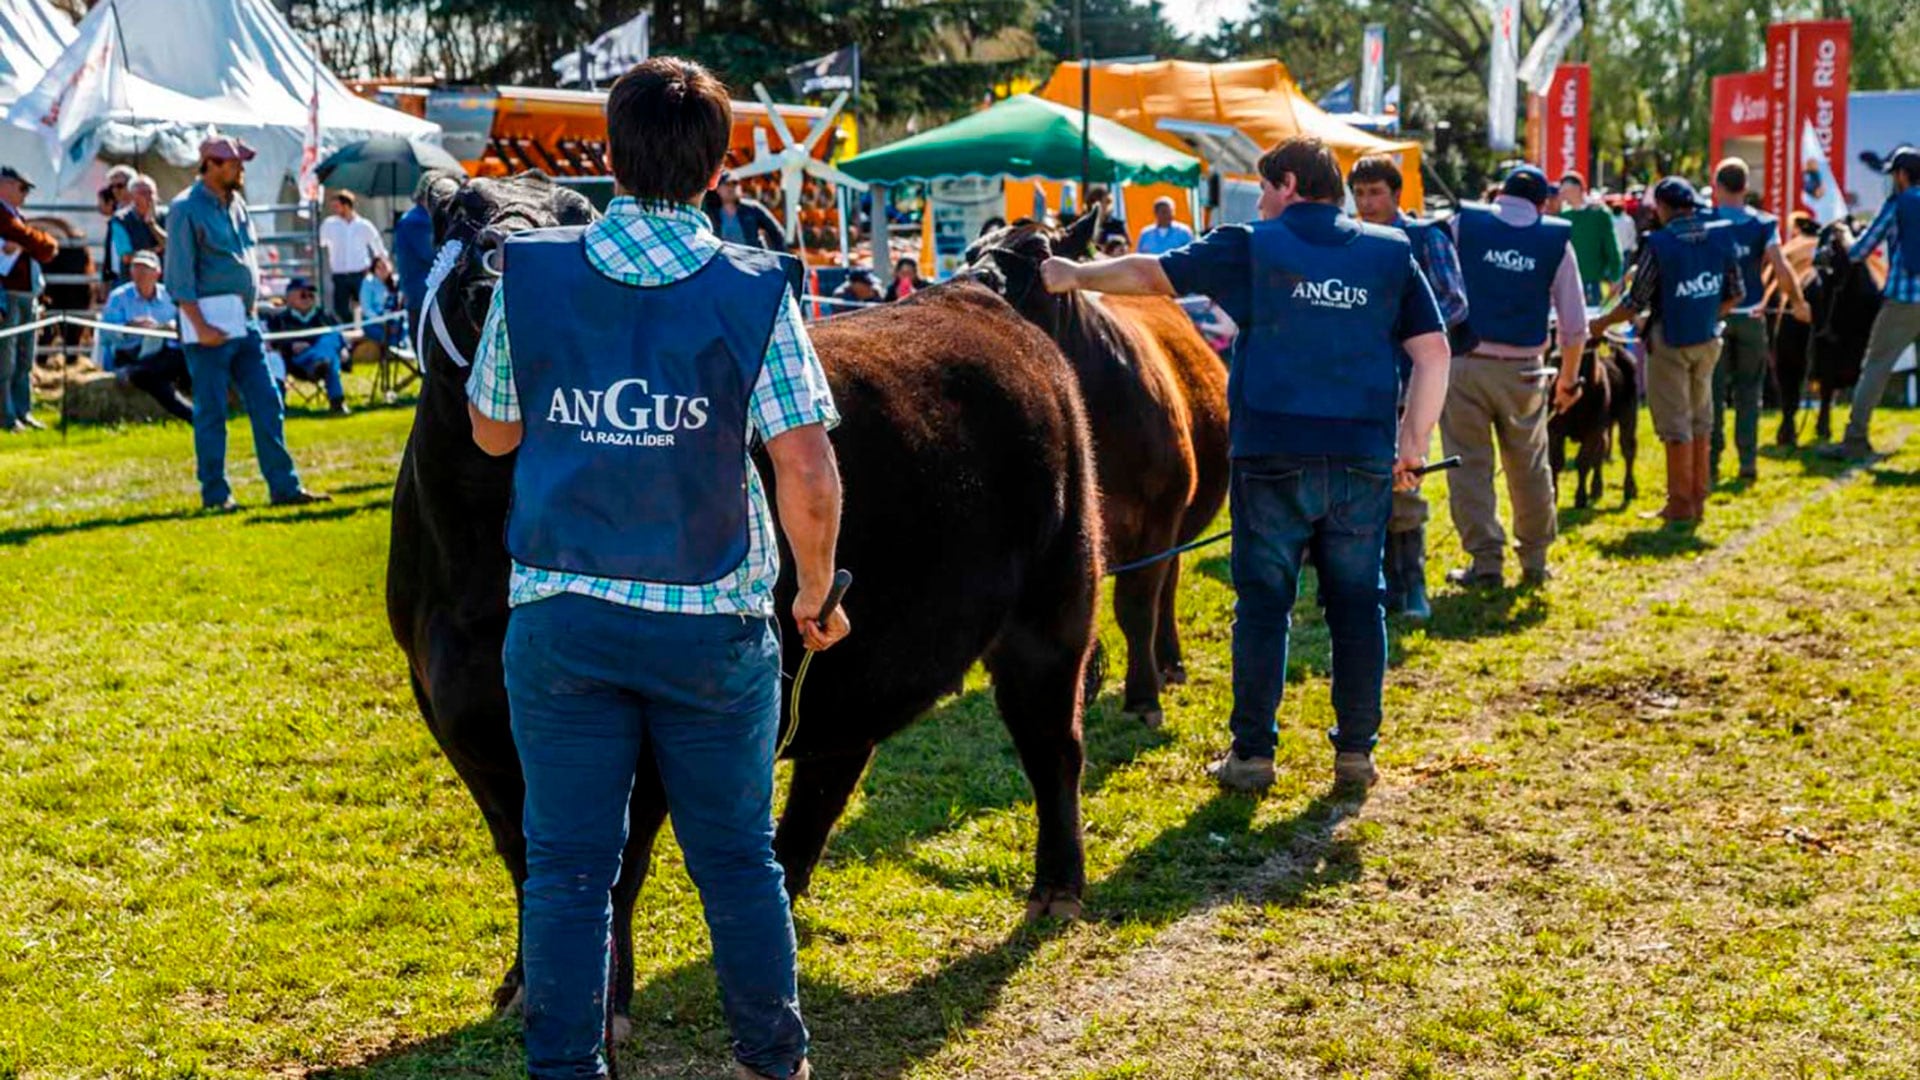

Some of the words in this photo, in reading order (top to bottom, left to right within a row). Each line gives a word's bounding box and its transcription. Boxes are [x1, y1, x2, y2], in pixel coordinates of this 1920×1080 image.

[1483, 248, 1536, 271] ANGUS
[1291, 278, 1368, 306] ANGUS
[1675, 271, 1723, 297] ANGU
[546, 378, 710, 431] ANGUS
[580, 430, 594, 443] LA
[596, 431, 634, 445] RAZA
[635, 432, 675, 446] LÍDER
